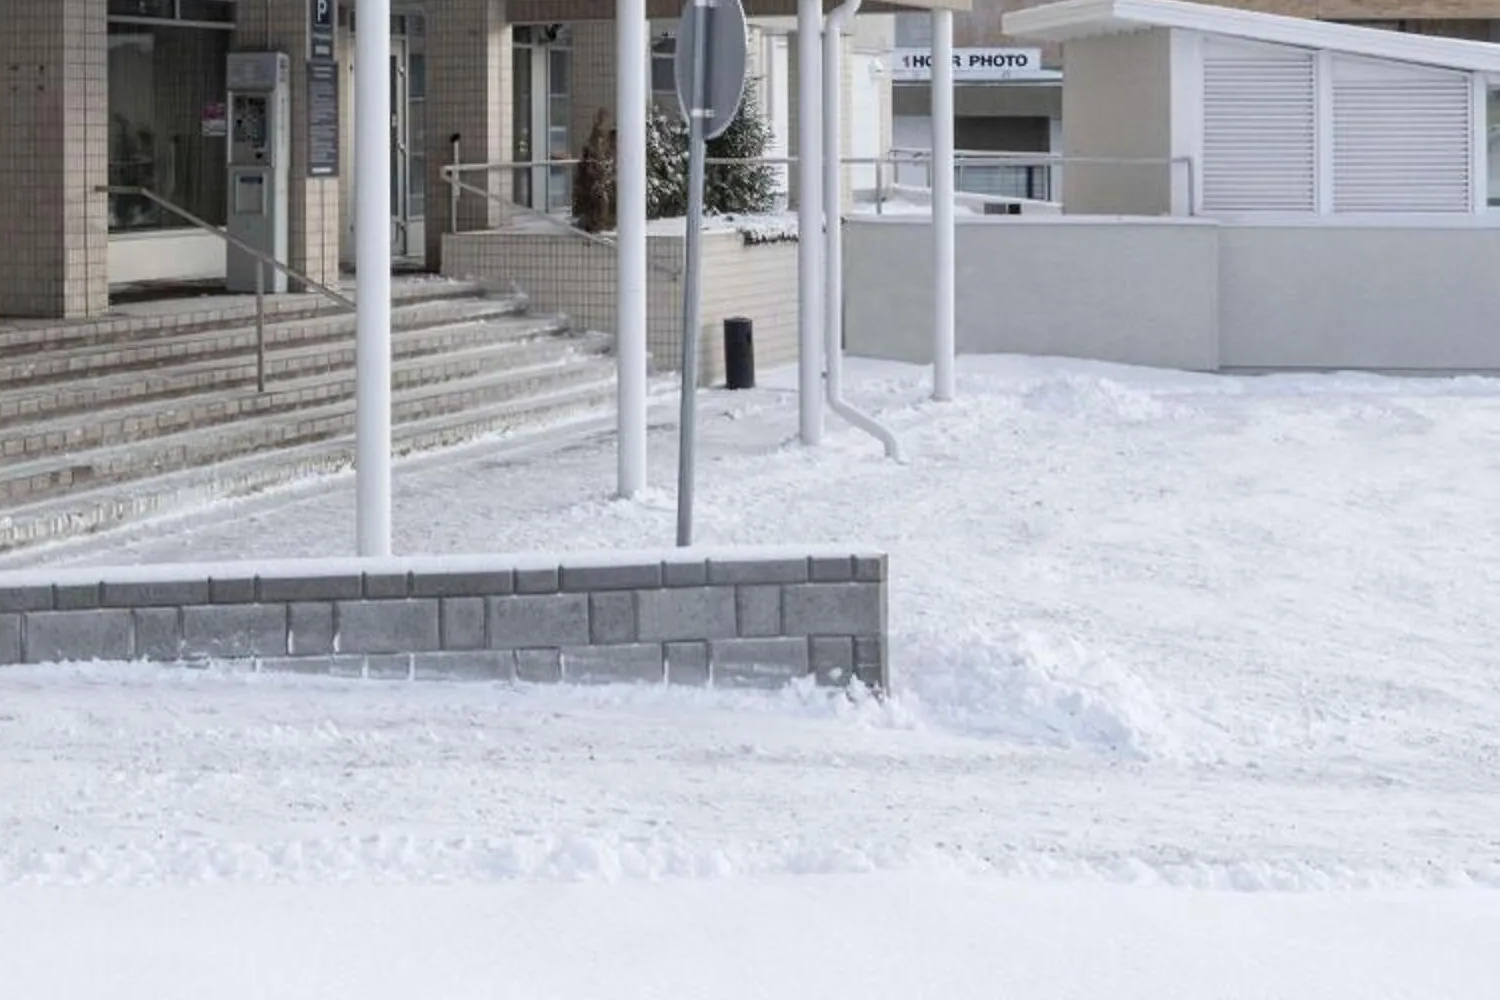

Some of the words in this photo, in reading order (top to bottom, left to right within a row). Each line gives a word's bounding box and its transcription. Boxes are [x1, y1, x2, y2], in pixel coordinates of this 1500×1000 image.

[317, 0, 328, 22] P
[913, 55, 962, 68] HOR
[970, 54, 1028, 68] PHOTO
